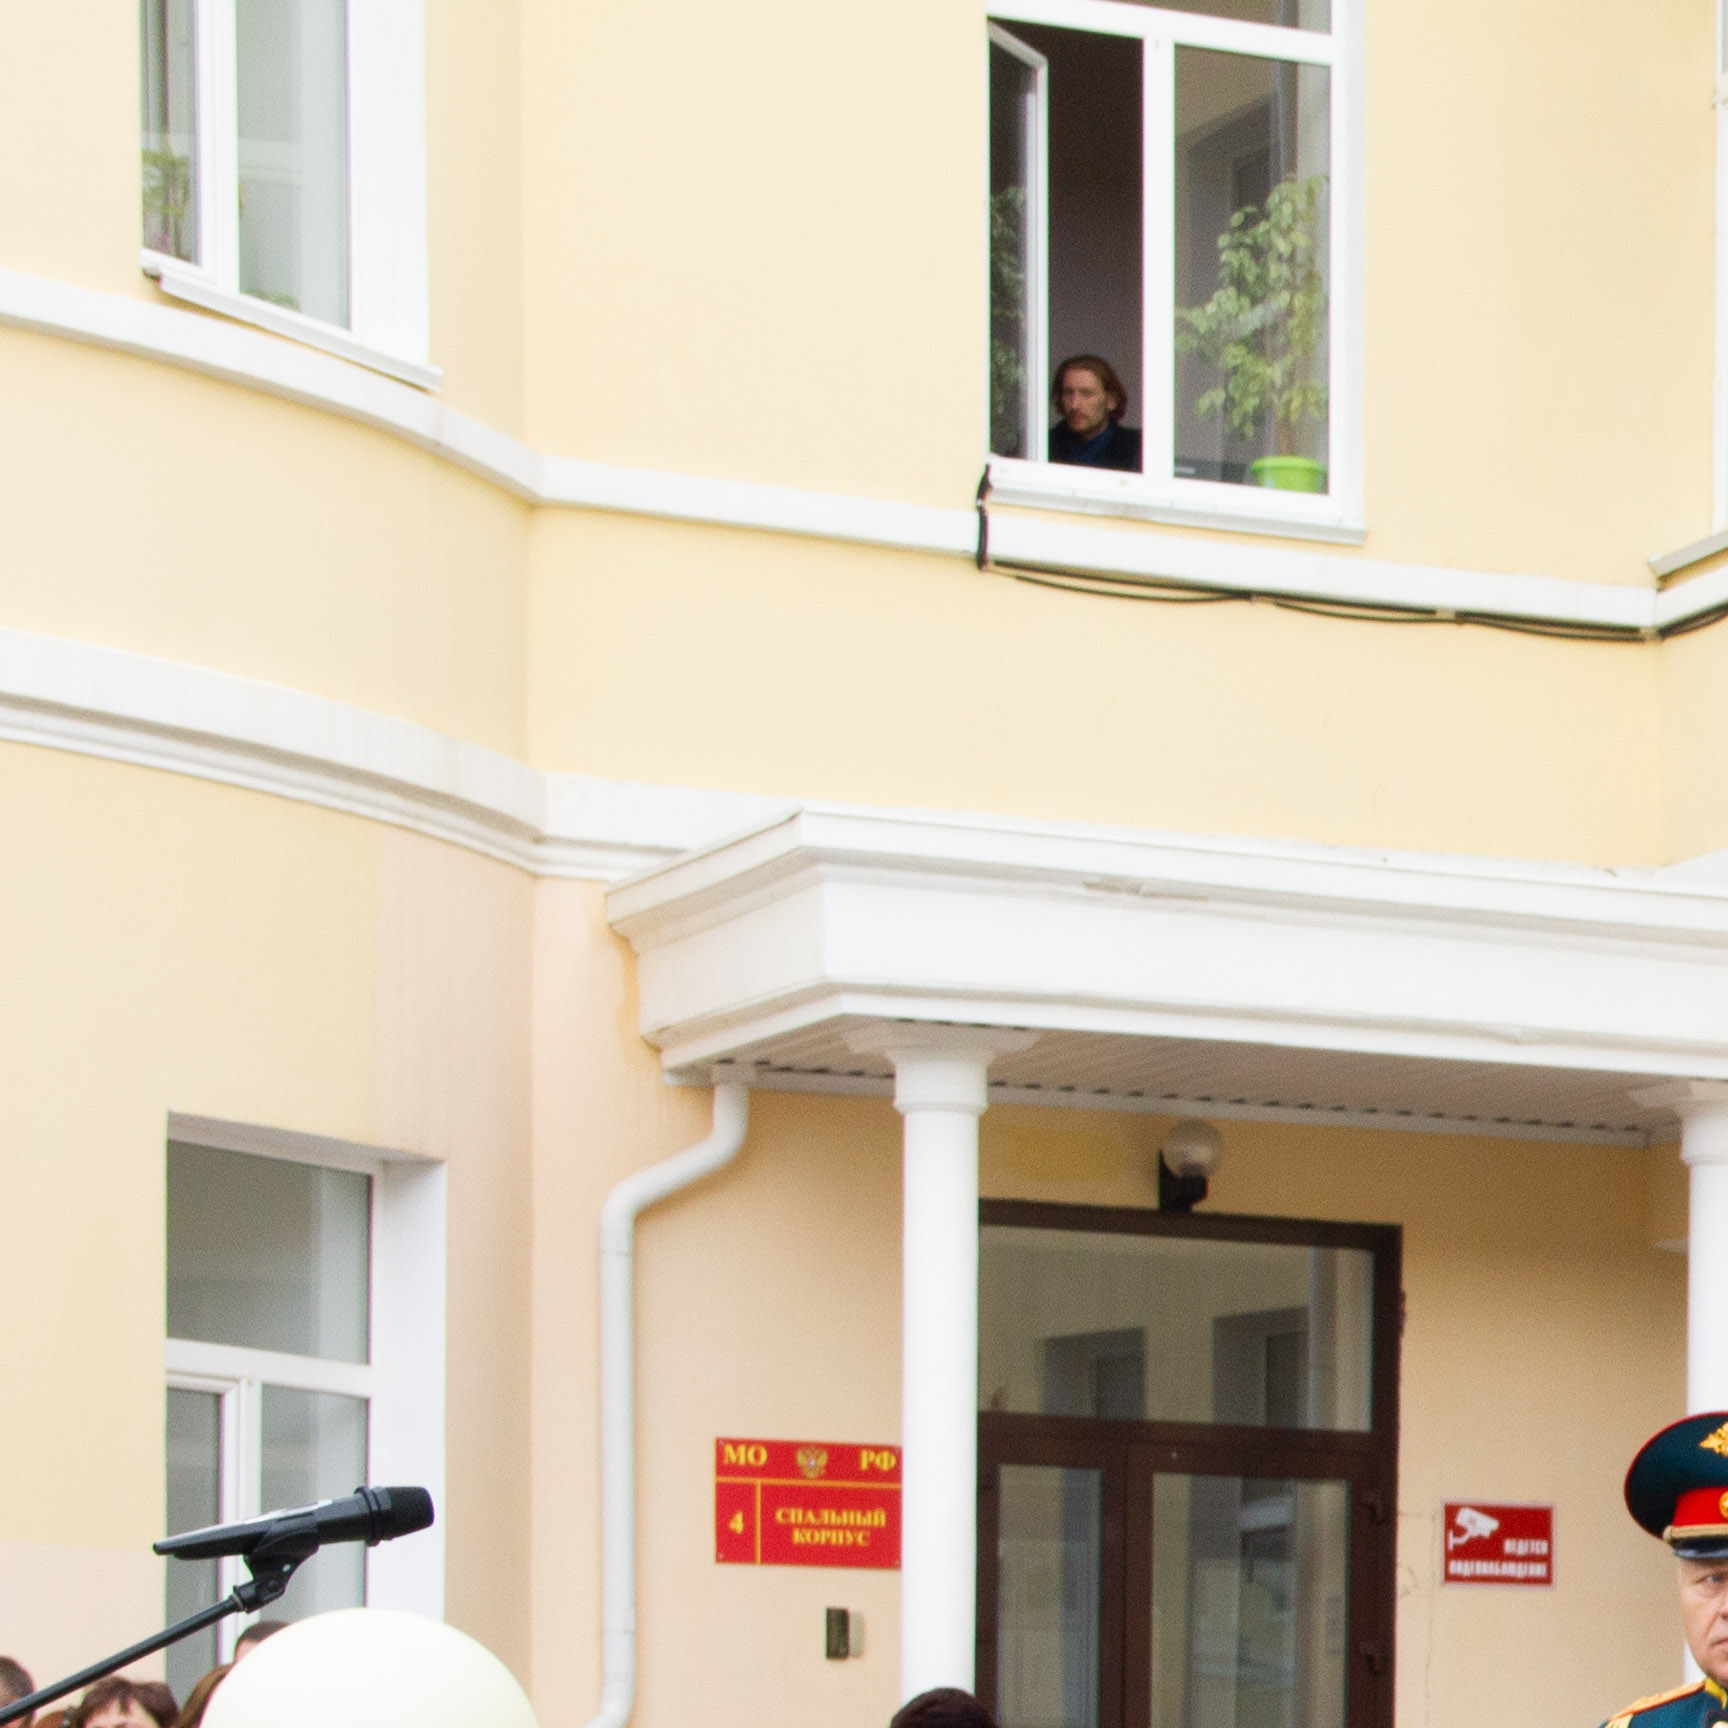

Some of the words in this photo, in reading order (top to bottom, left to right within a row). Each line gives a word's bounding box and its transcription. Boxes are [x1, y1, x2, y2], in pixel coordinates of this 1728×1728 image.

[723, 1443, 768, 1467] МО
[859, 1449, 897, 1472] РФ
[728, 1511, 745, 1534] 4
[775, 1507, 887, 1528] СПАЛЬНЫЙ
[792, 1527, 870, 1547] КОРПУС
